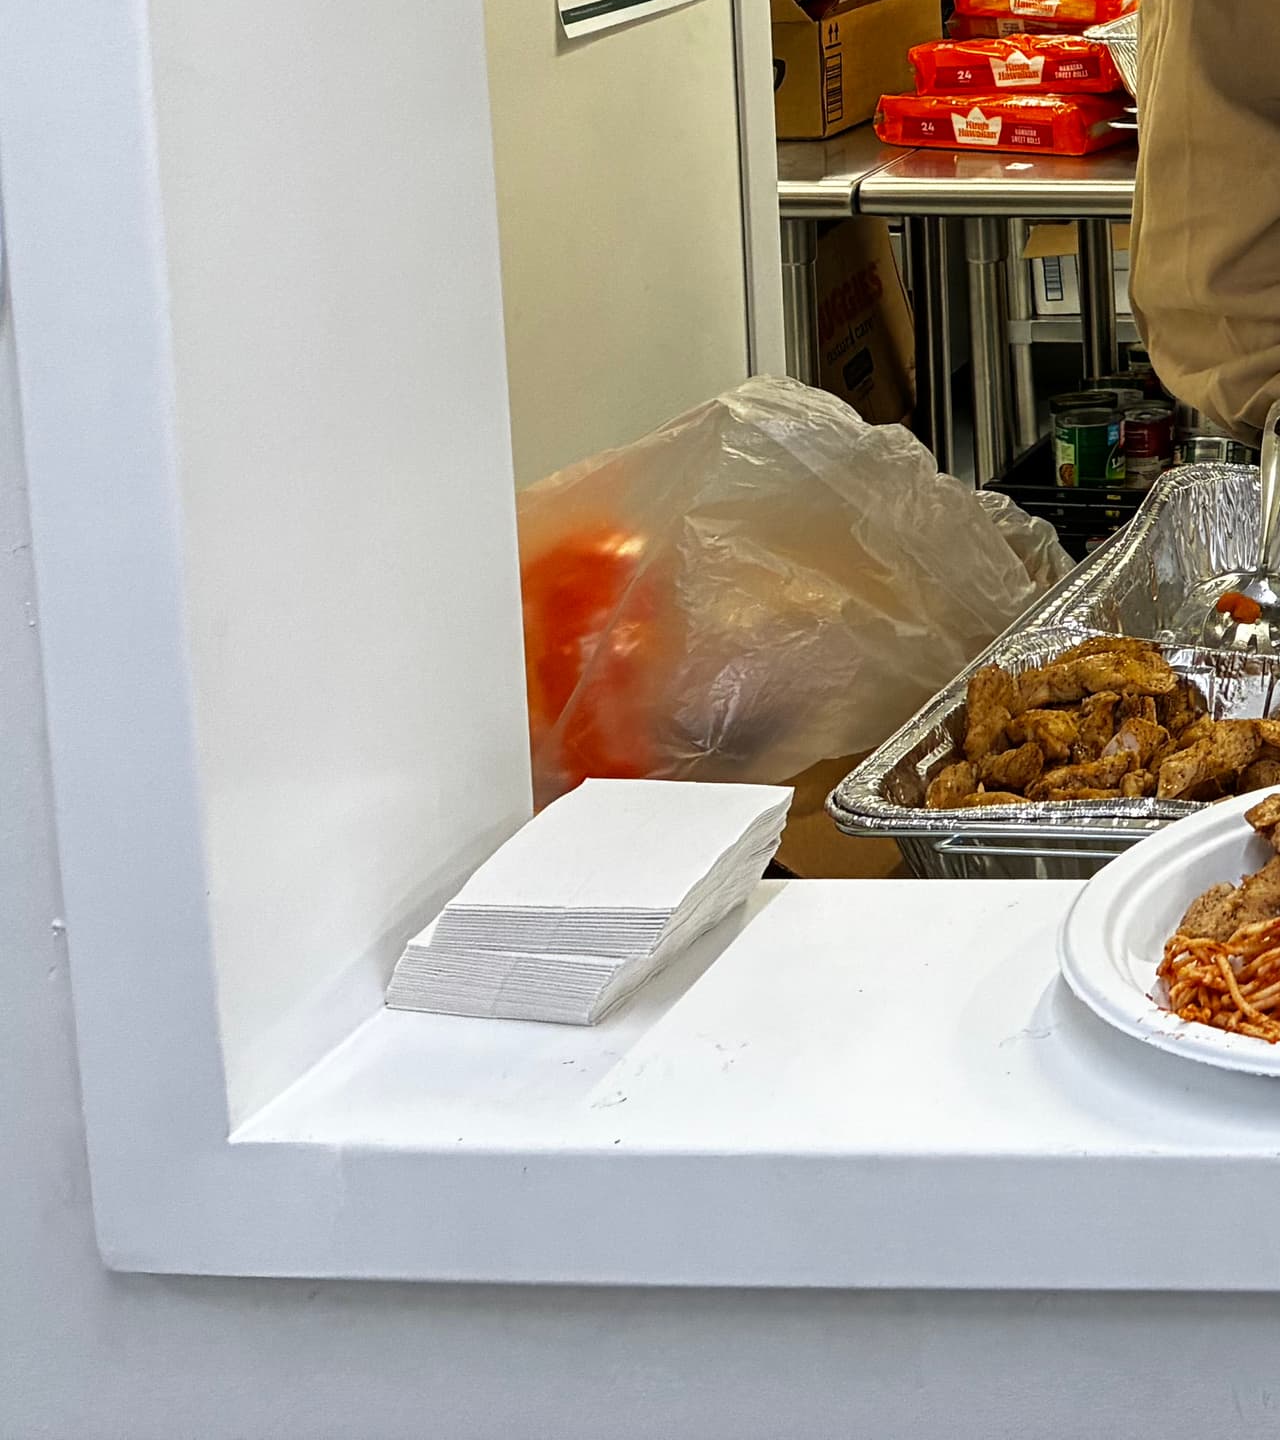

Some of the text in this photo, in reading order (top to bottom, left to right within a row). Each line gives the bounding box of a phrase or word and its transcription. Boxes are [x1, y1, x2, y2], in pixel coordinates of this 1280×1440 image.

[956, 70, 972, 80] 24
[998, 70, 1039, 81] Hawaiian
[920, 122, 935, 132] 24
[965, 120, 990, 131] King's
[957, 128, 997, 140] Hawaiian
